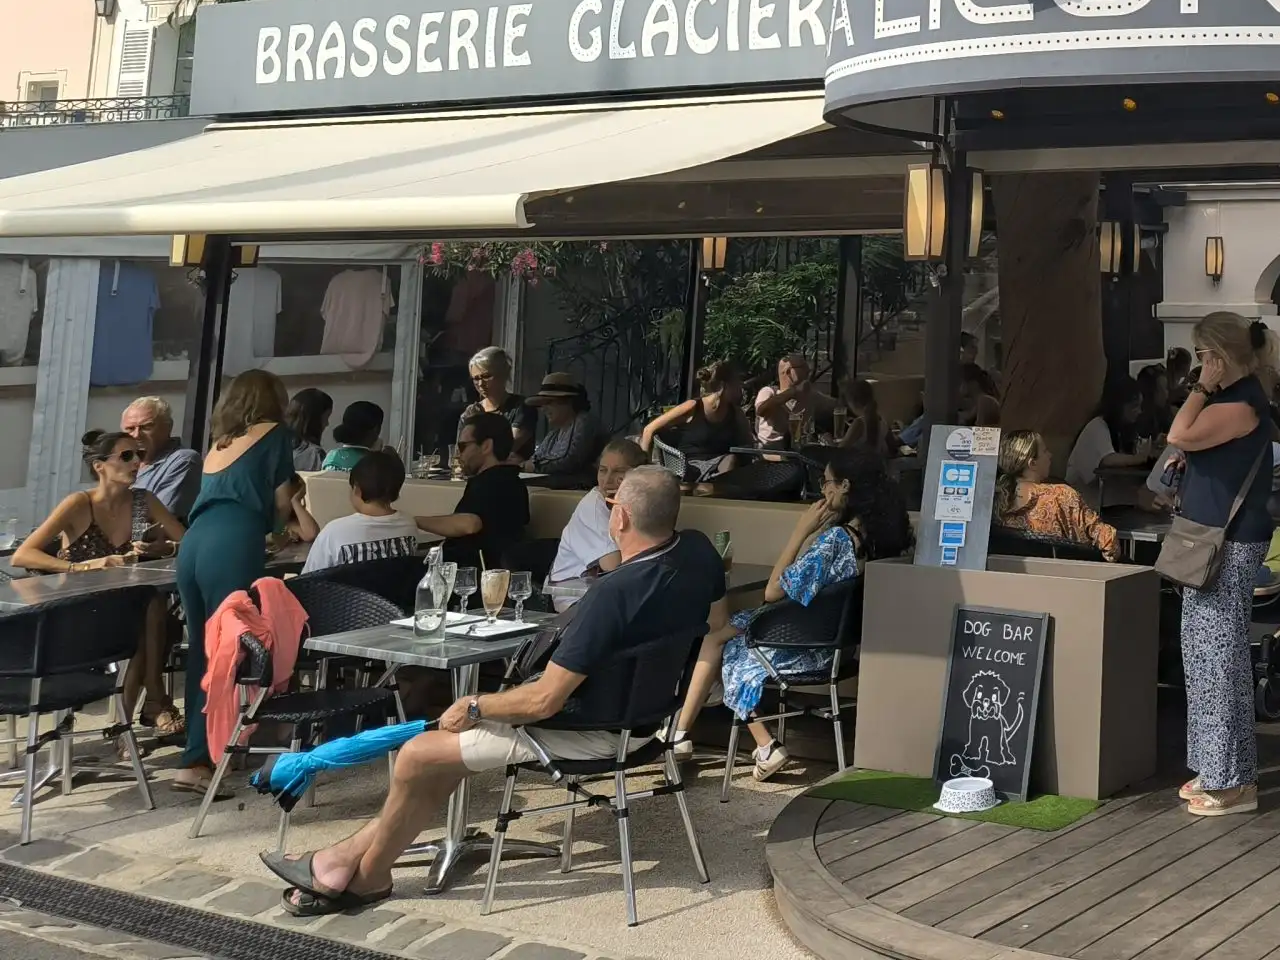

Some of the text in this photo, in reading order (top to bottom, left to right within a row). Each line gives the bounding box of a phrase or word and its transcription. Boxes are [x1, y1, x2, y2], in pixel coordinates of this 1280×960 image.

[254, 2, 533, 86] BRASSERIE
[964, 620, 1034, 642] DOG BAR
[962, 644, 1027, 666] WELCOME
